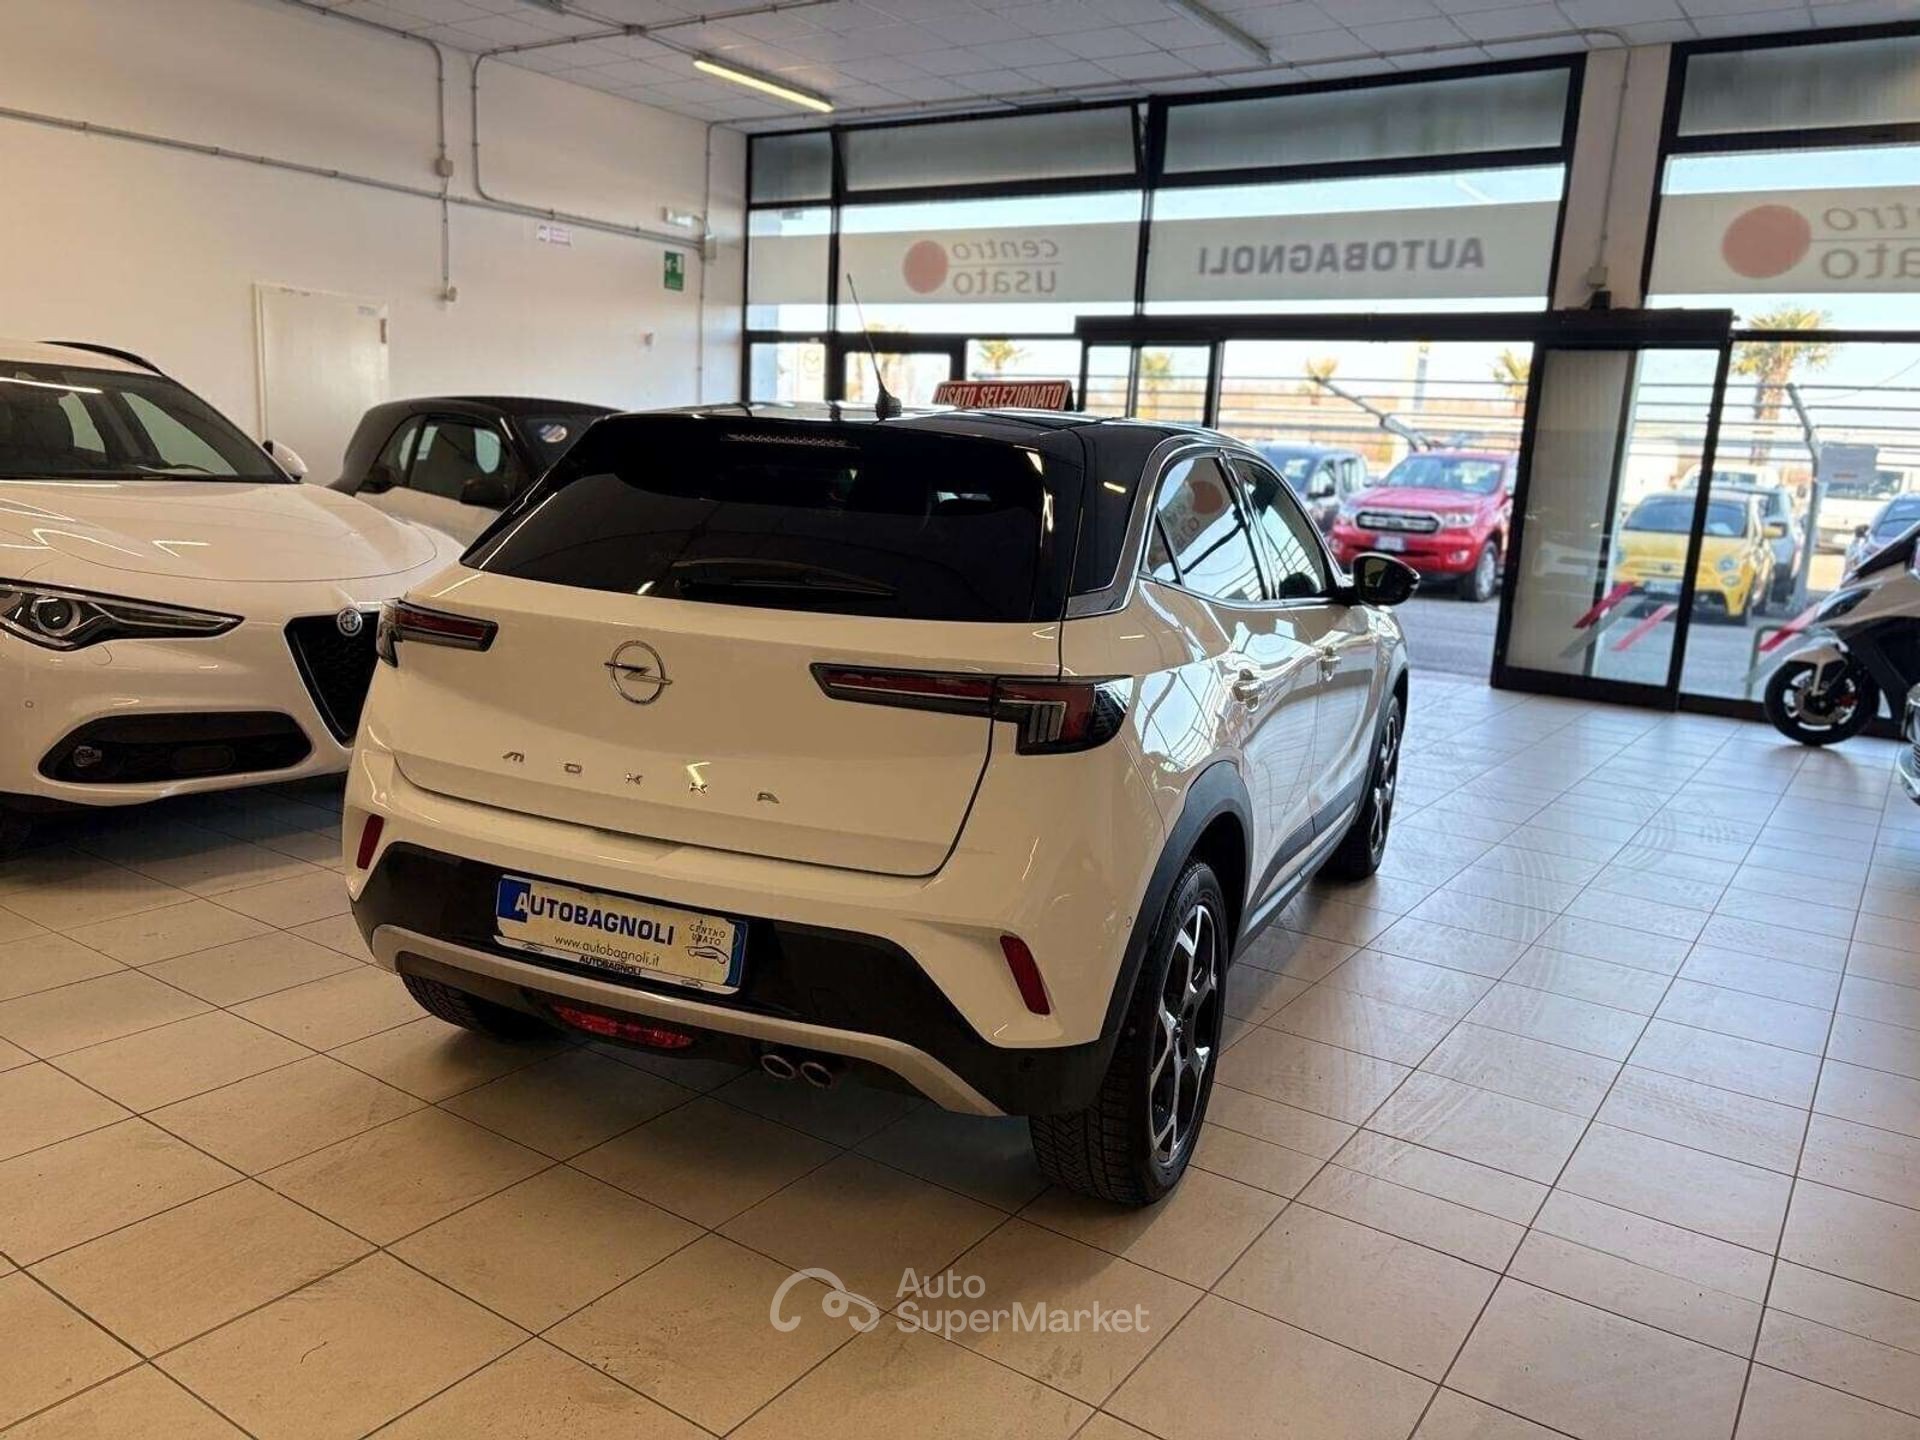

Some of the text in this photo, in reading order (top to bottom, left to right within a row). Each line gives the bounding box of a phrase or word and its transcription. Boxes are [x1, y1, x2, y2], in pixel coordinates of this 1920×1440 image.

[937, 384, 1062, 408] USATO SELEZIONATO
[502, 751, 781, 805] MOKKA
[514, 891, 675, 946] AUTOBAGNOLI
[554, 934, 660, 967] www.autobagnoli.it
[579, 954, 642, 976] AUTOBAGNOLI
